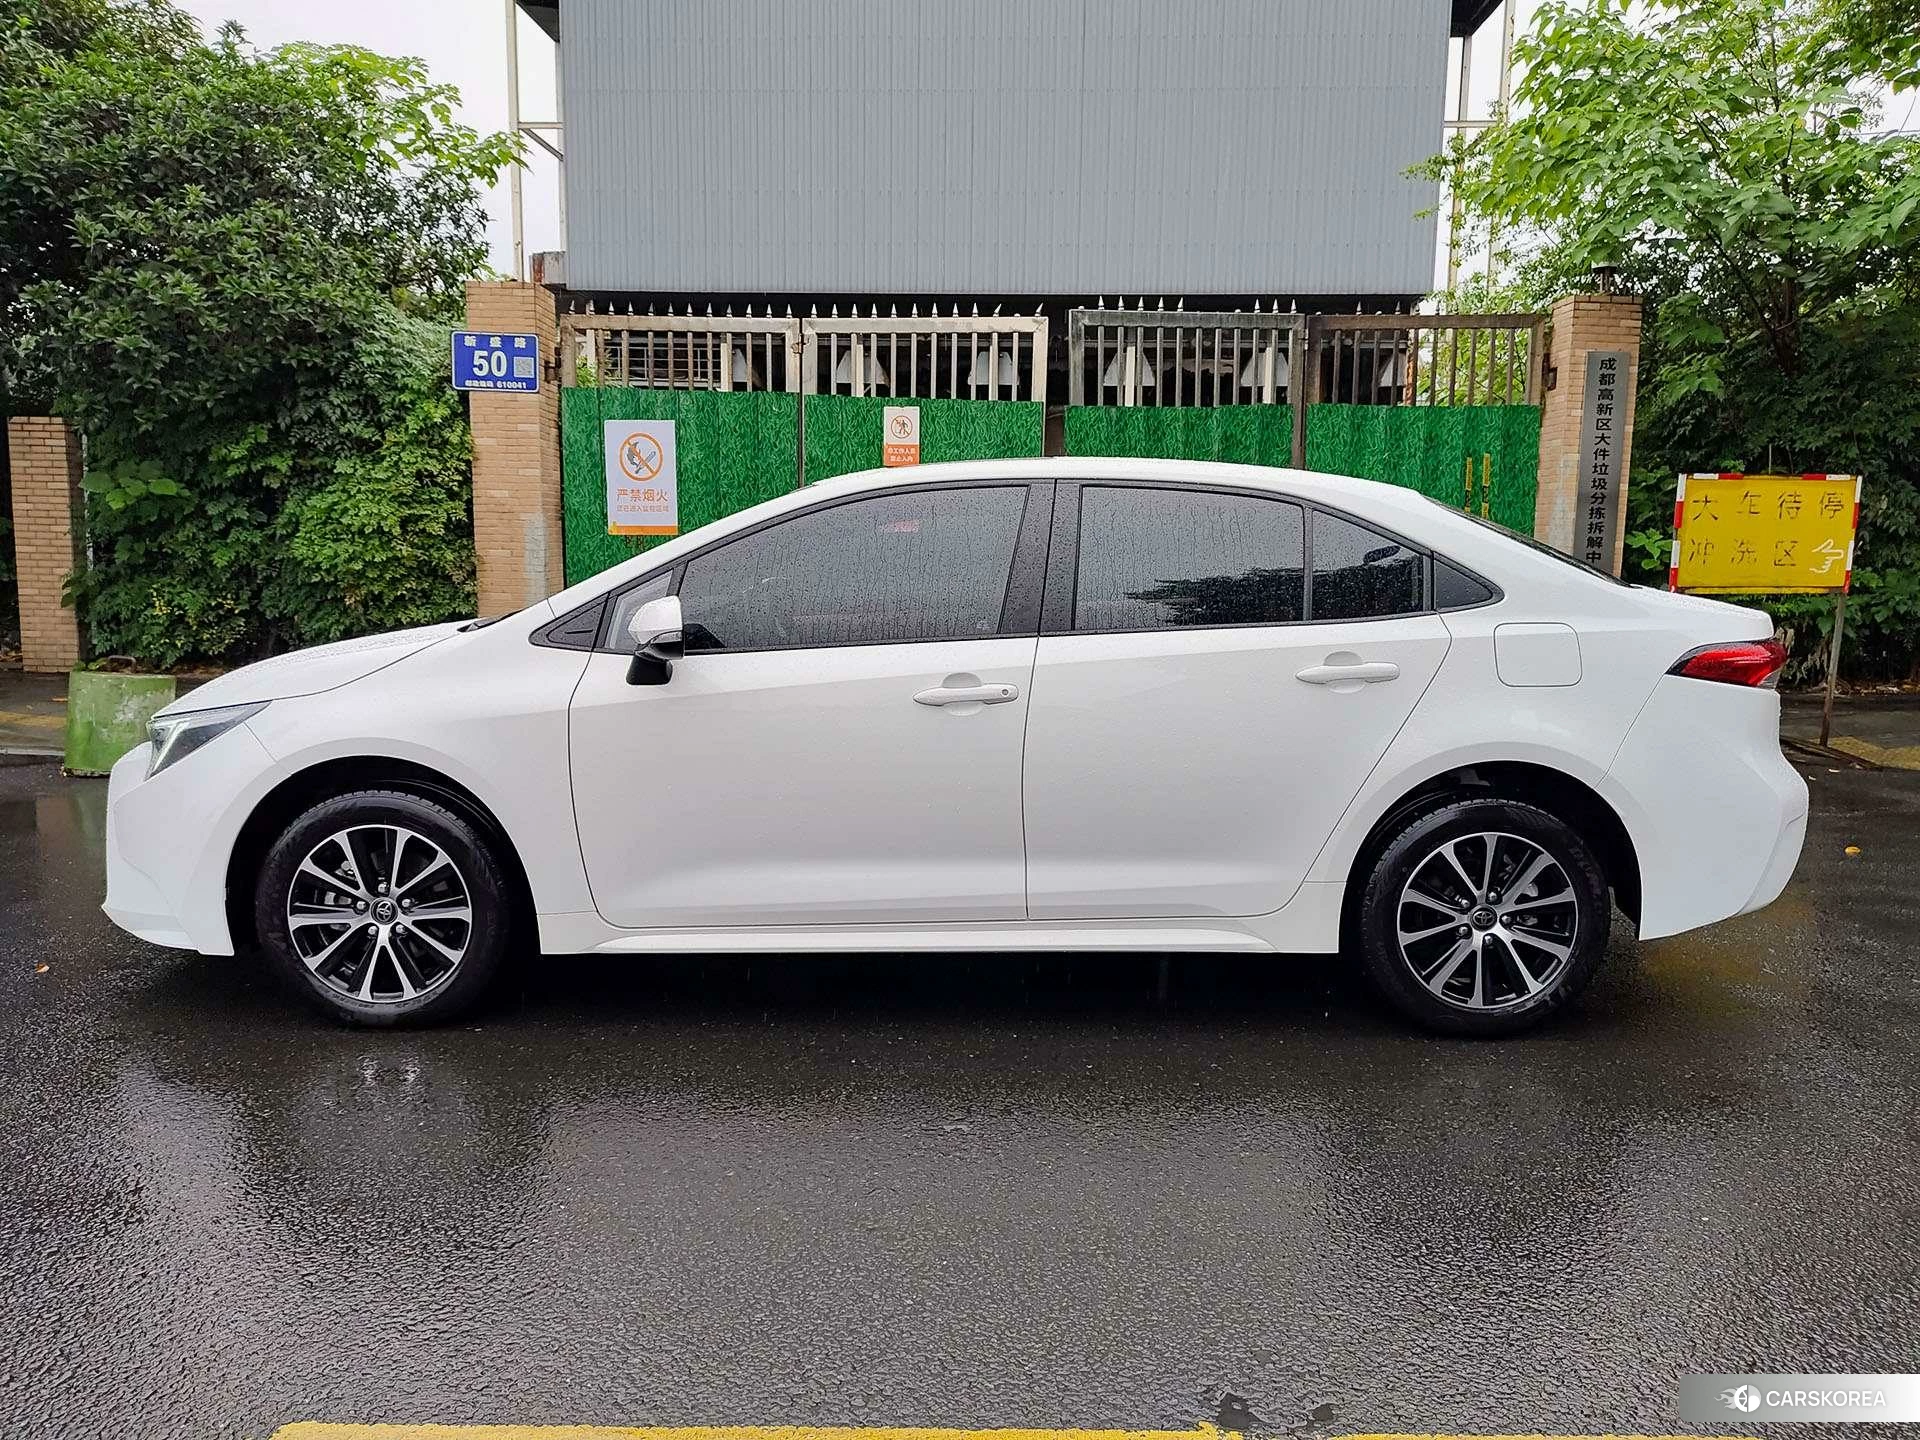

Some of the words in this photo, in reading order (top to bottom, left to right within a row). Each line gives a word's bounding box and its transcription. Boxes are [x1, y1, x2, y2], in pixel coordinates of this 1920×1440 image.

[472, 350, 508, 377] 50
[1585, 357, 1617, 564] 成都高新区大件垃圾分拣拆解中
[616, 488, 669, 502] 严禁烟火
